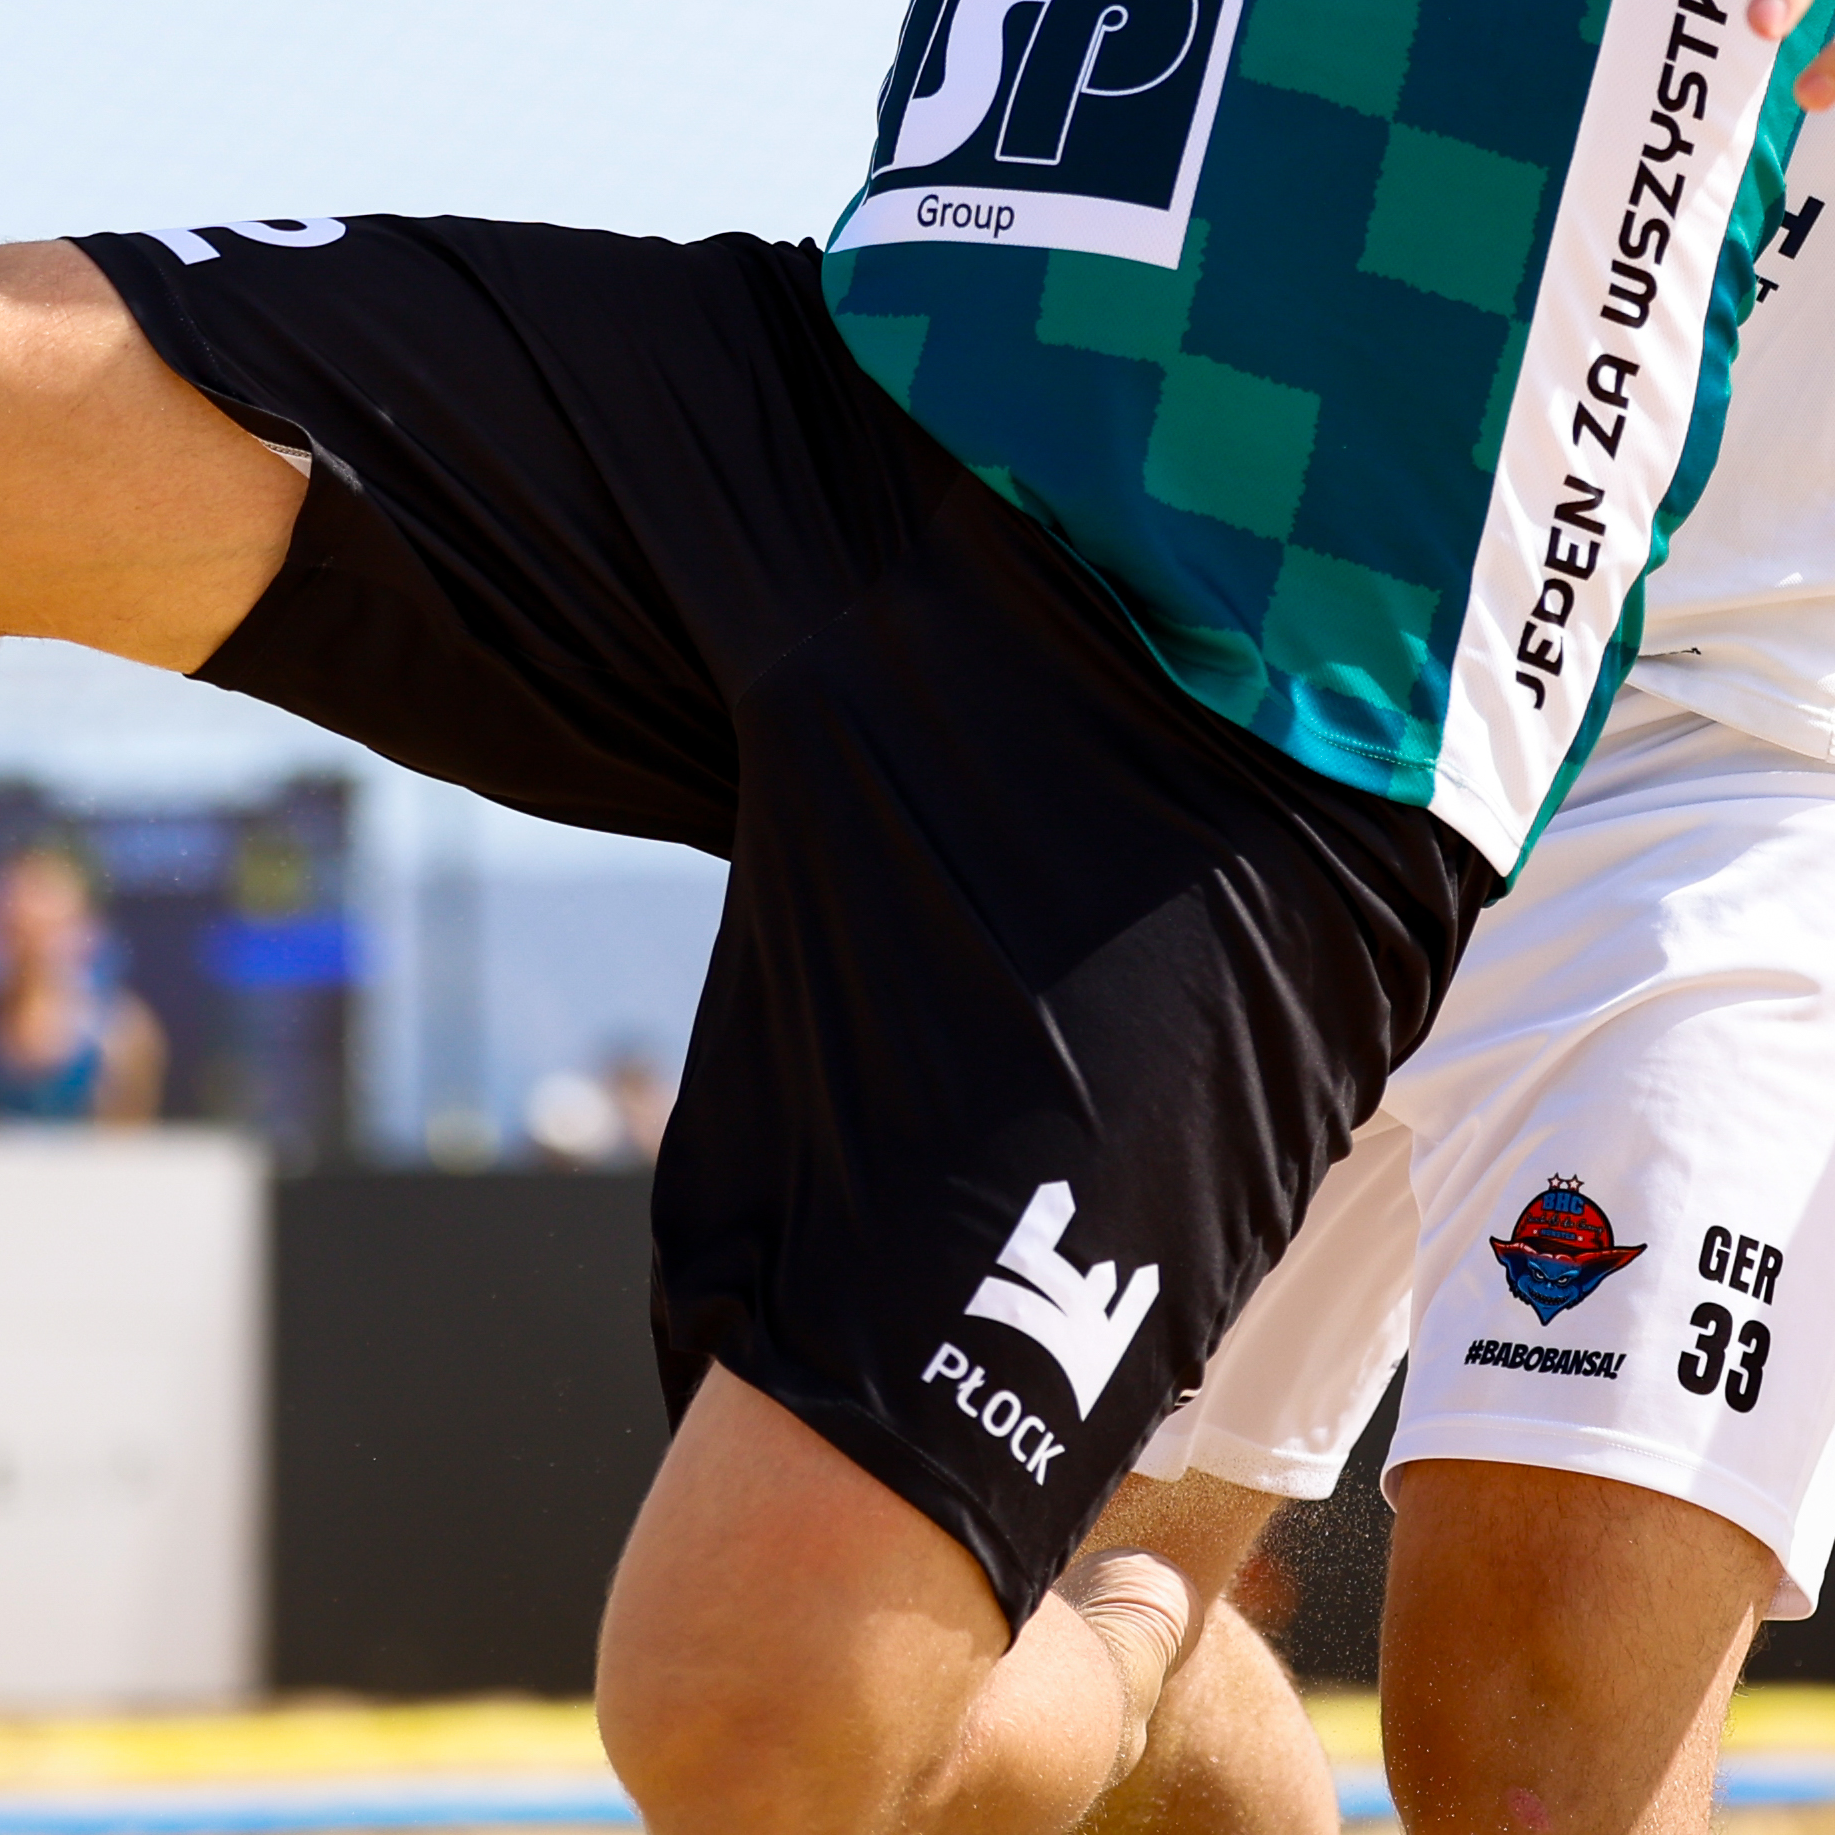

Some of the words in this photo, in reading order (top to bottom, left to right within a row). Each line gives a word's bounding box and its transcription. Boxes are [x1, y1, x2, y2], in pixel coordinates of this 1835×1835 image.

[917, 194, 1015, 238] Group
[1516, 474, 1606, 710] JEDEN
[1572, 361, 1641, 460] ZA
[1543, 1192, 1584, 1215] BHC
[1698, 1225, 1784, 1306] GER
[1464, 1339, 1627, 1379] #BABOBANSA!
[1677, 1302, 1771, 1414] 33
[921, 1341, 1066, 1486] PŁOCK
